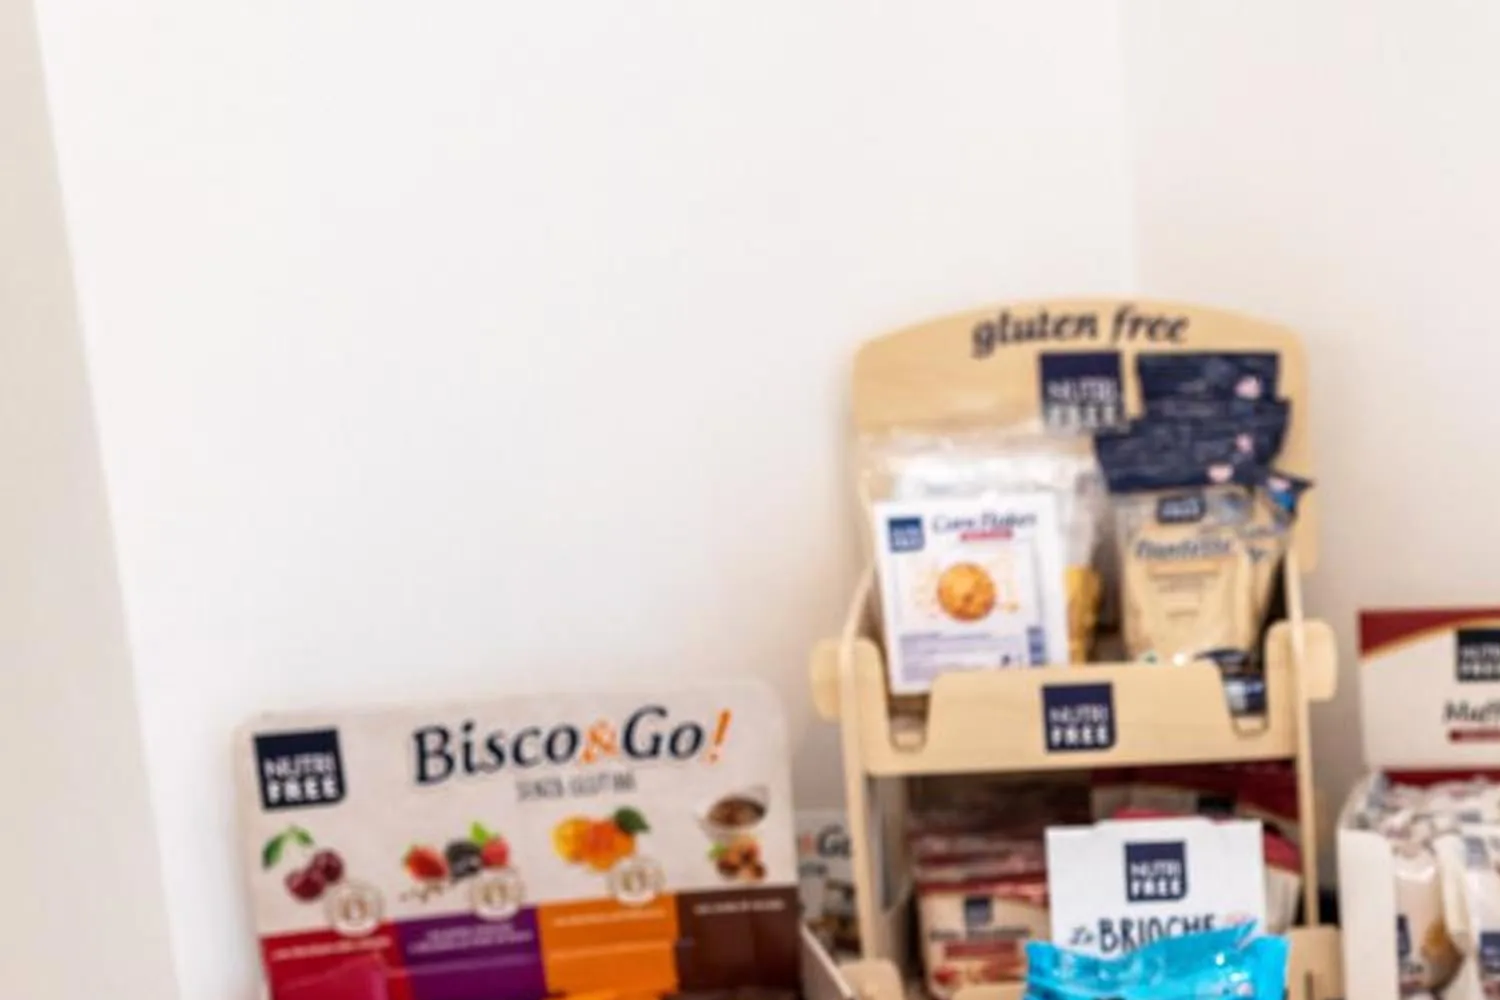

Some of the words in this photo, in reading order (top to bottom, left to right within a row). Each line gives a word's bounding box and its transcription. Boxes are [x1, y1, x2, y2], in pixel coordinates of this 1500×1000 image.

[972, 307, 1098, 359] gluten
[1110, 303, 1190, 345] free
[412, 704, 733, 786] Bisco&Go!
[266, 778, 340, 804] FREE
[1131, 879, 1181, 897] FREE
